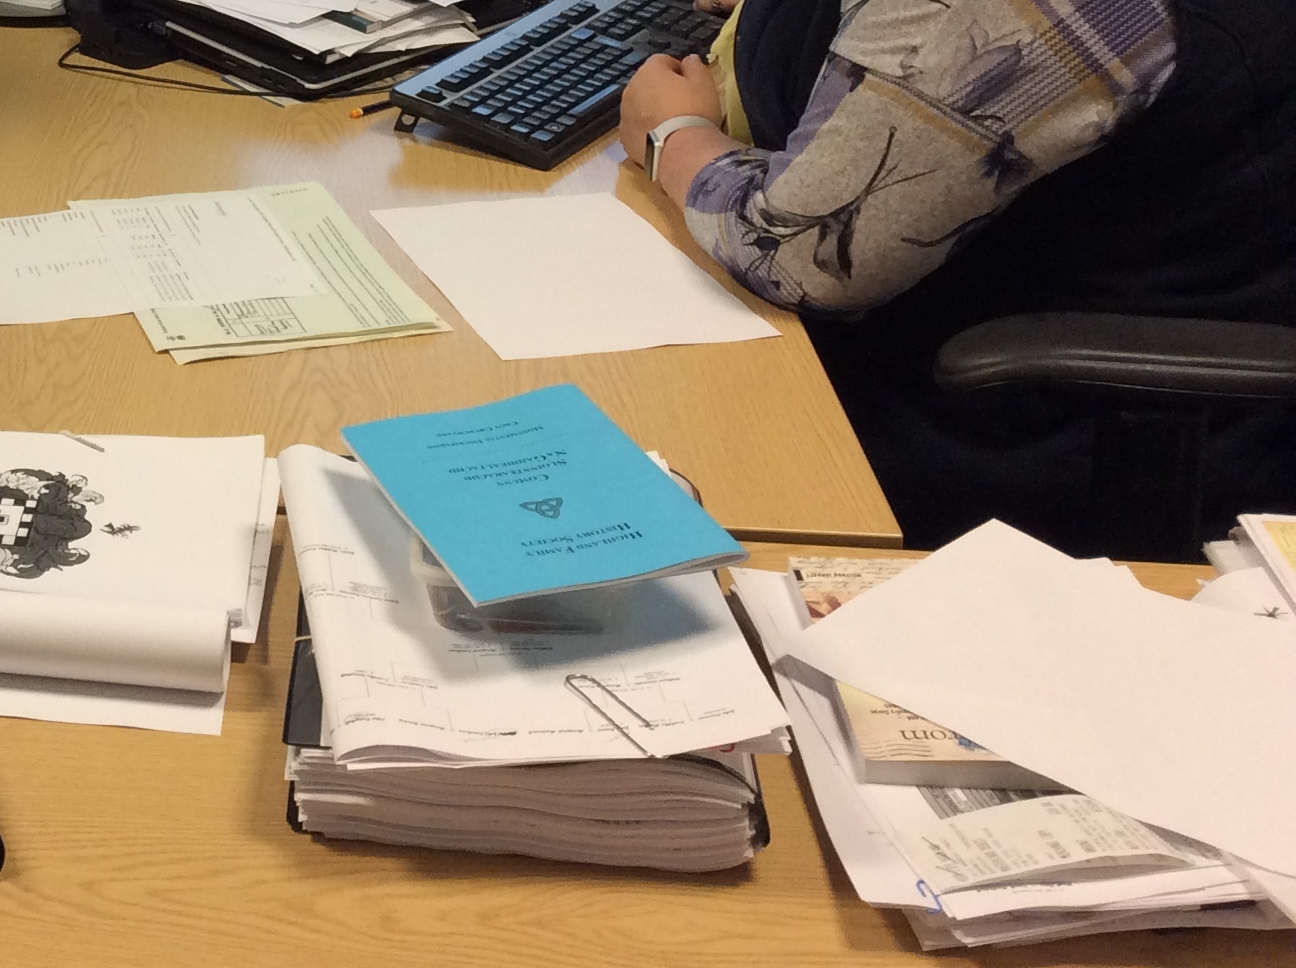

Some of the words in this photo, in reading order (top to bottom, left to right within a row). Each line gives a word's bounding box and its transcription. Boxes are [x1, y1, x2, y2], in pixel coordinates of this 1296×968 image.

[576, 522, 631, 539] HISTORY
[520, 535, 574, 547] SOCIETY
[576, 531, 643, 550] HIGHLAND
[526, 545, 575, 557] FAMILY
